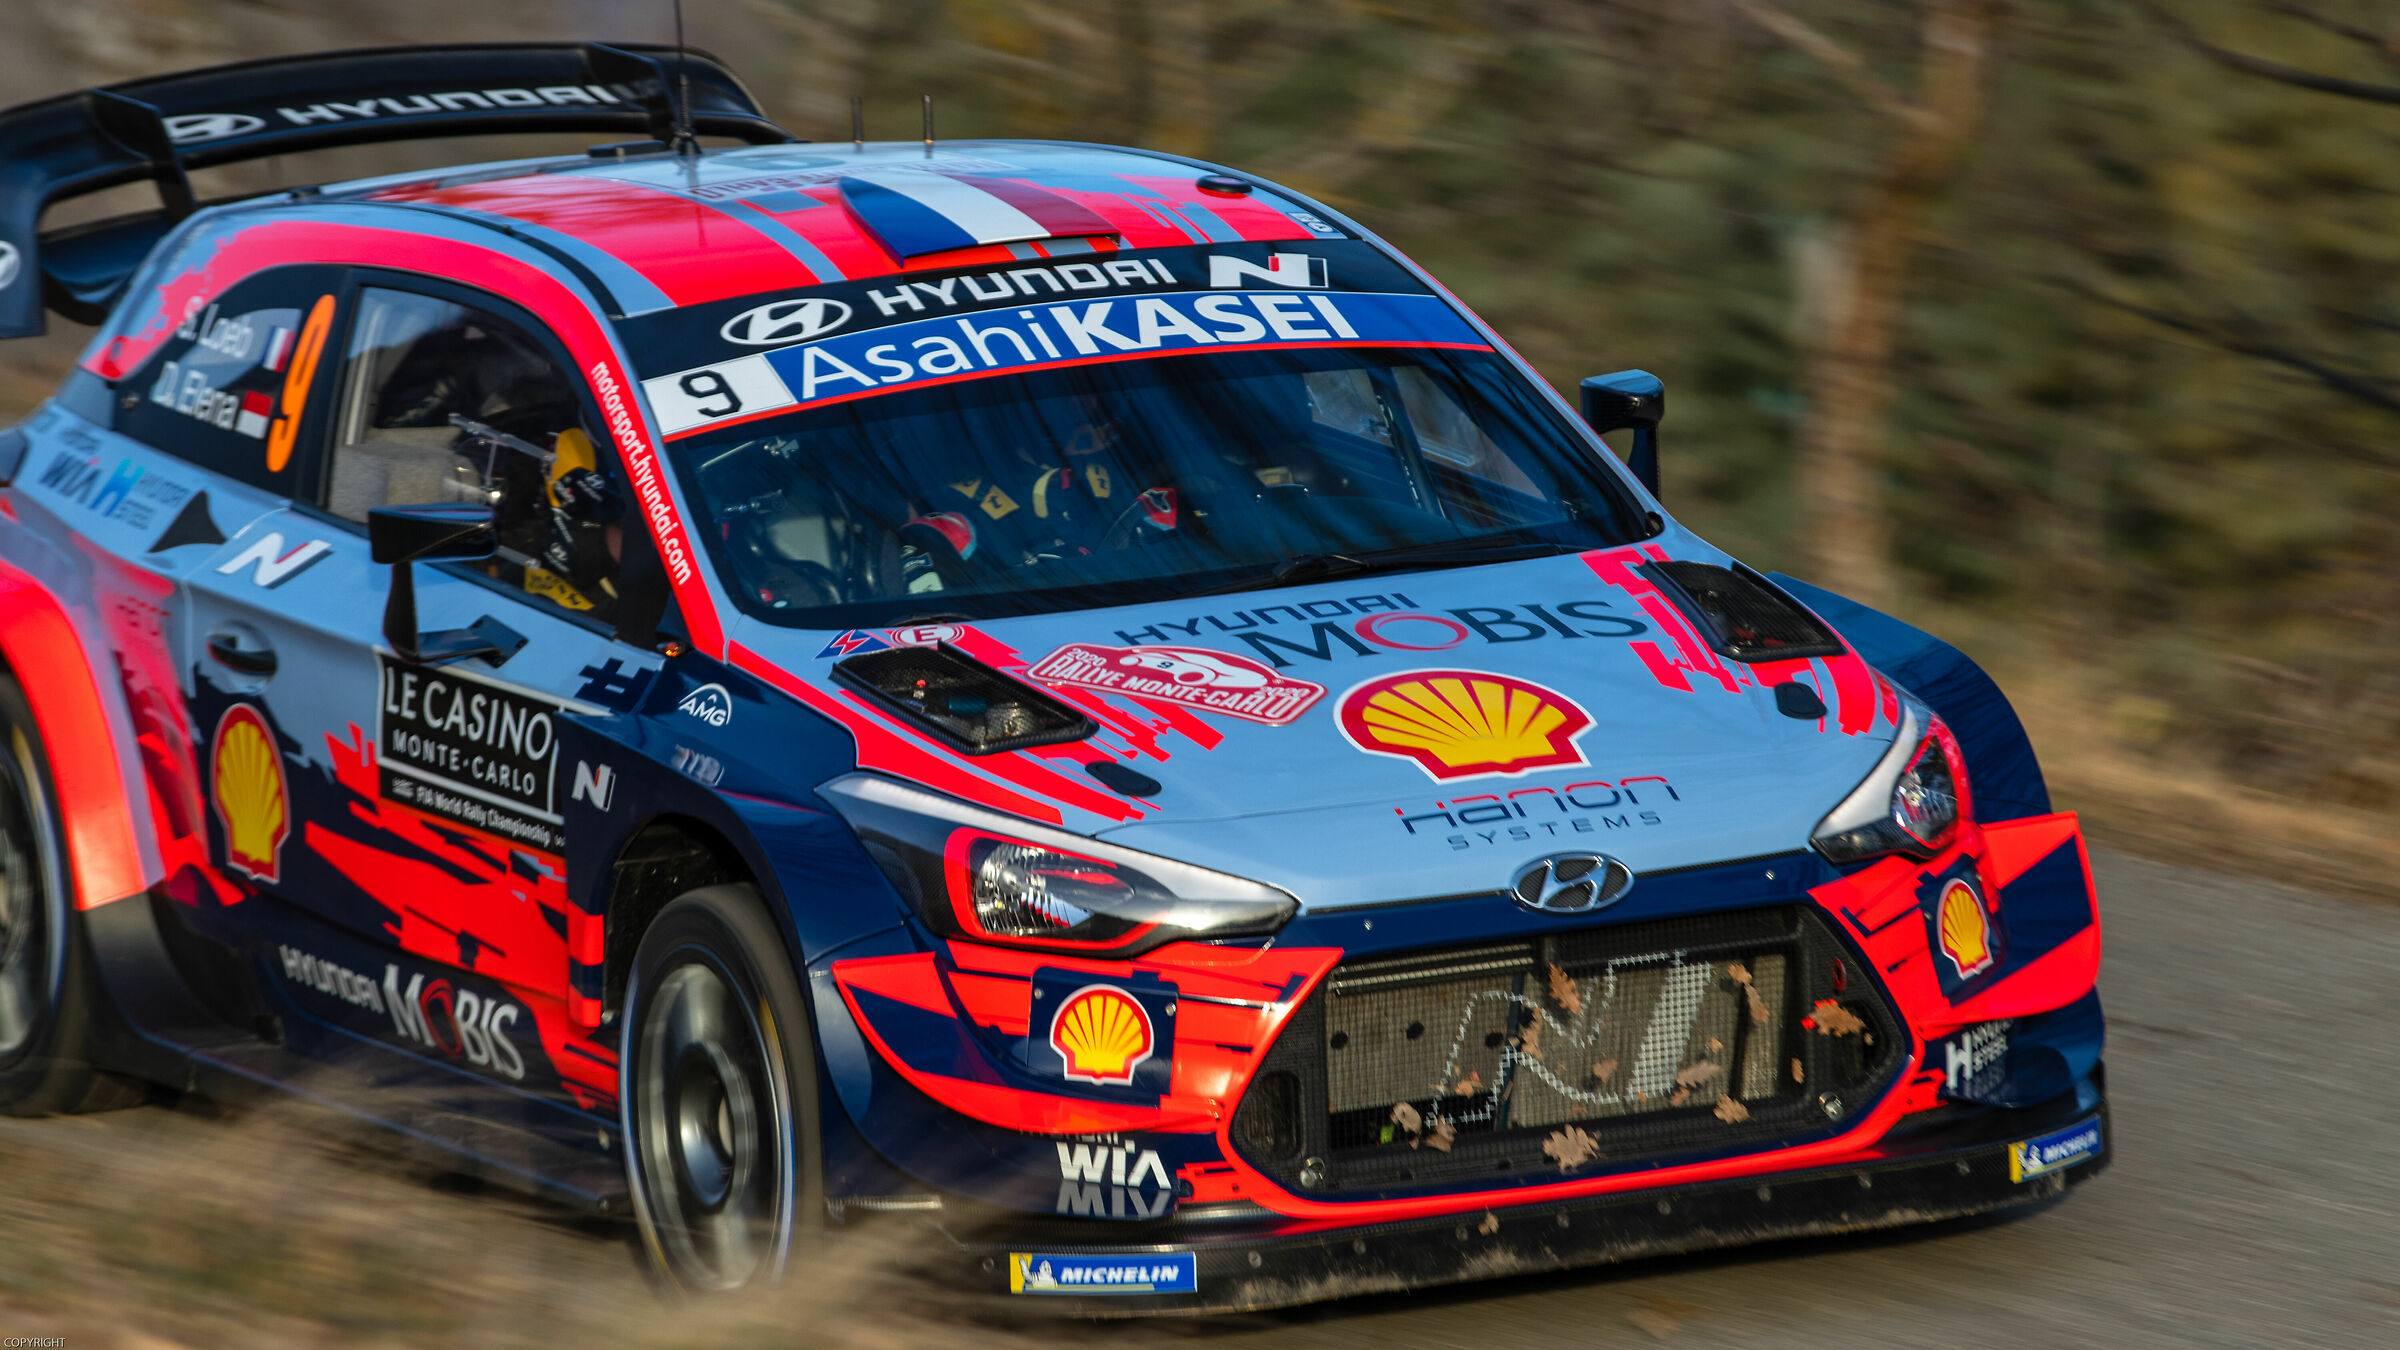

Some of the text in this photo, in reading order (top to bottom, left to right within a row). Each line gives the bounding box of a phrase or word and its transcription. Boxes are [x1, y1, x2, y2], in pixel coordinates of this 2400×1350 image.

[276, 85, 622, 126] HYUNDAI
[866, 258, 1178, 317] HYUNDAI
[197, 303, 254, 359] Loeb
[176, 369, 240, 431] Elena
[266, 294, 336, 472] 9
[678, 369, 743, 418] 9
[590, 361, 692, 587] motorsport.hyundai.com
[913, 626, 943, 643] E
[1114, 592, 1422, 646] HYUNDAI
[1232, 600, 1649, 668] MOBIS
[1068, 647, 1107, 667] 2020
[385, 666, 553, 761] LE CASINO
[678, 696, 727, 727] AMG
[1040, 656, 1301, 718] RALLYE MONTE-CARLO
[1252, 686, 1310, 698] 2020
[417, 786, 434, 807] FIA
[434, 790, 463, 816] World
[463, 800, 487, 827] Rally
[488, 808, 550, 848] Championship
[1446, 810, 1662, 851] SYSTEMS
[279, 943, 526, 1081] HYUNDAI MOBIS
[1056, 1139, 1172, 1189] WIA
[1060, 1264, 1179, 1284] MICHELIN
